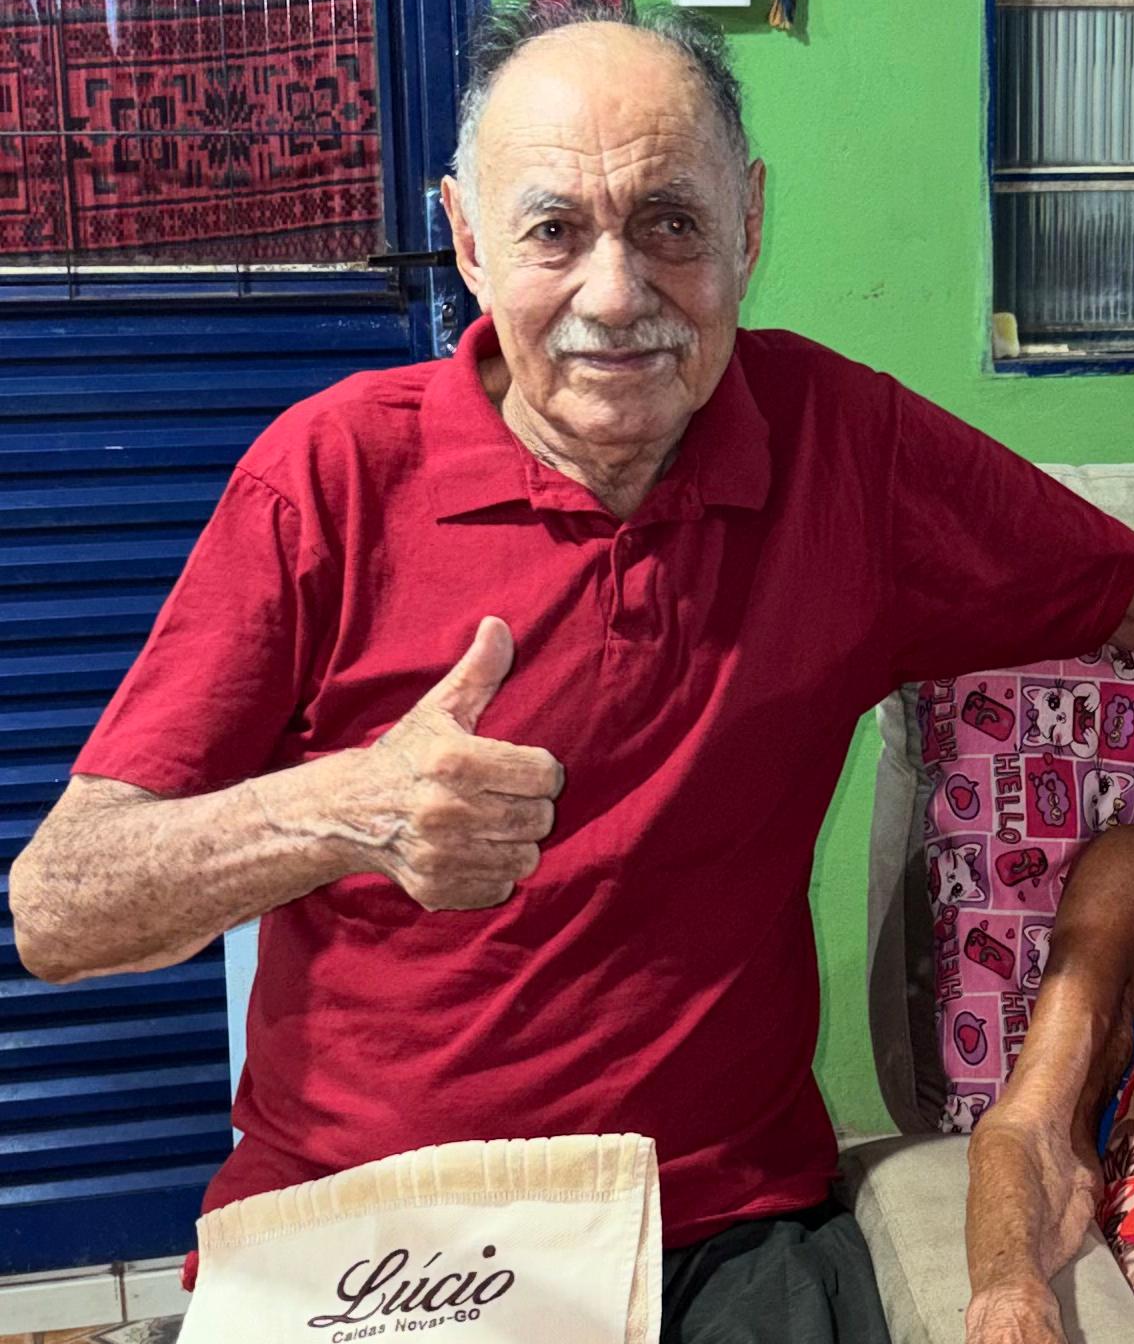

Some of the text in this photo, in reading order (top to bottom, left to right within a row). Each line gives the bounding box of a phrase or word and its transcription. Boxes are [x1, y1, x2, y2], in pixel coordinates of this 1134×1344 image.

[993, 752, 1026, 845] HELLO
[307, 1244, 515, 1328] Lúcio
[331, 1308, 481, 1344] Caldas Novas-GO
